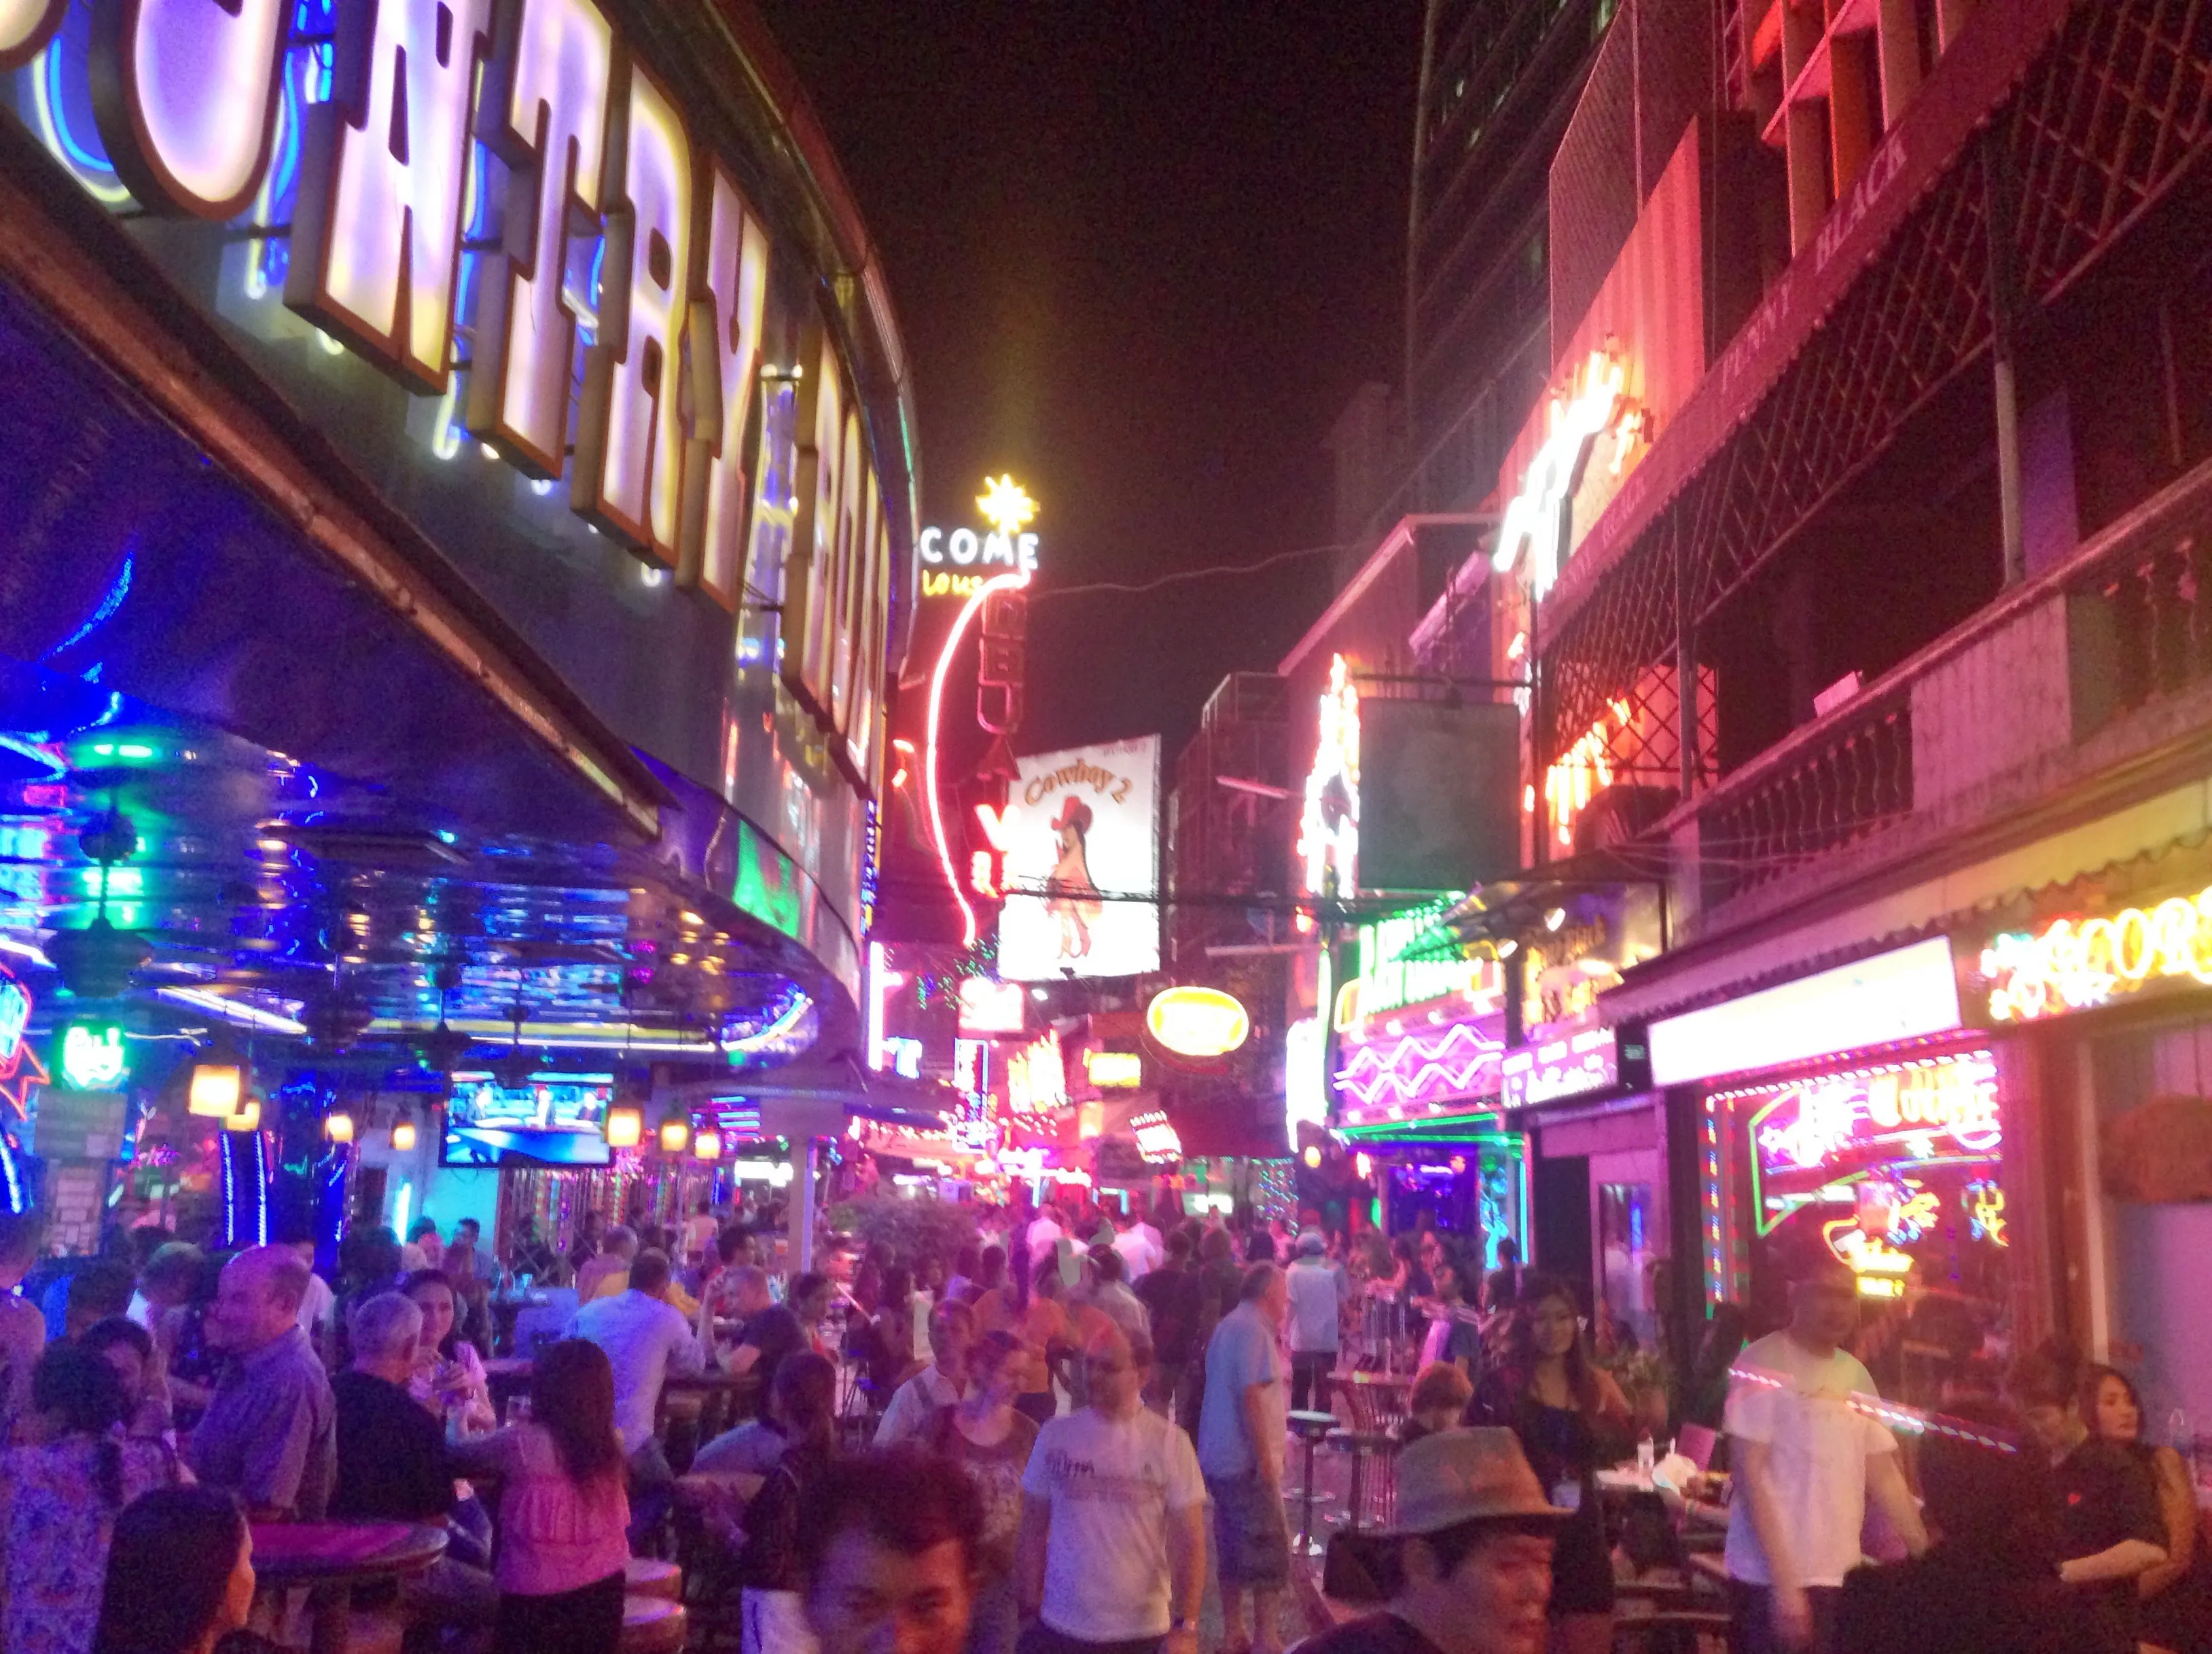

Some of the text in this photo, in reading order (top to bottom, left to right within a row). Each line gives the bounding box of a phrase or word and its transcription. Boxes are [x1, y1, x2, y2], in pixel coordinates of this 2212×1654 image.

[1815, 132, 1908, 274] BLACK
[920, 526, 1039, 569] COME
[1024, 757, 1134, 807] Cowboy 2
